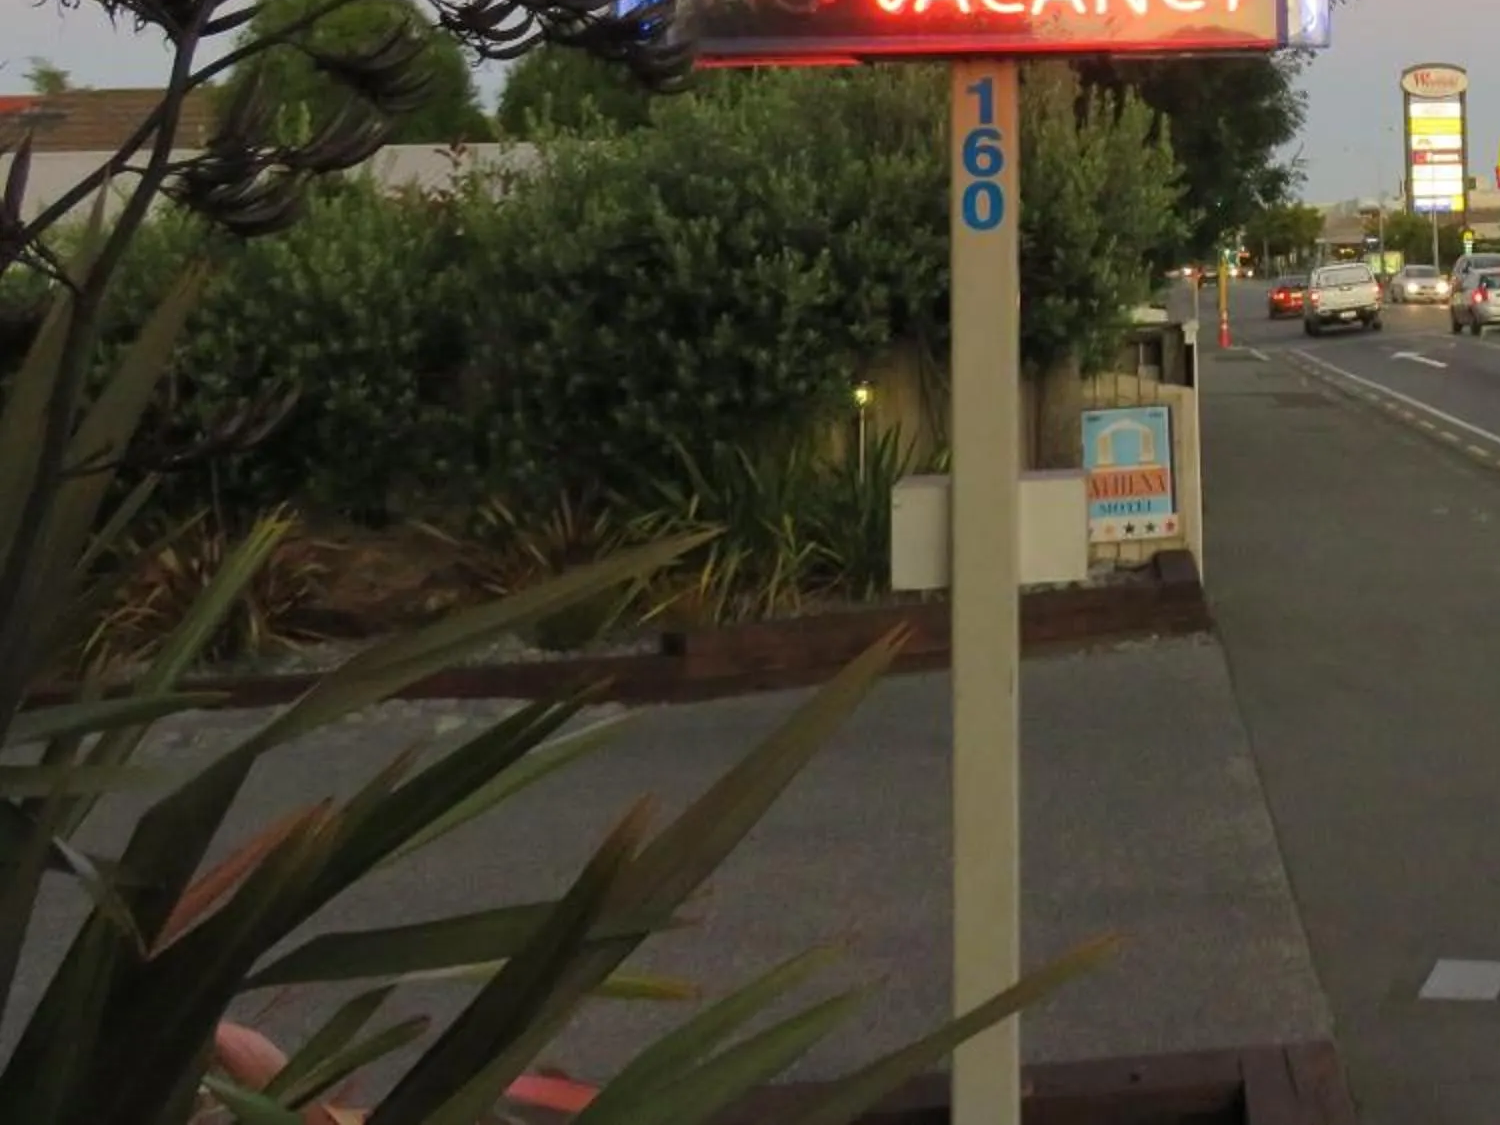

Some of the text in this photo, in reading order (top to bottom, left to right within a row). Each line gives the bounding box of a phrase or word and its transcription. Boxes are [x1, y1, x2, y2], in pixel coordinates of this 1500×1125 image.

[962, 76, 1005, 231] 160
[1089, 473, 1166, 499] ATHENA
[1099, 499, 1152, 514] MOTEL
